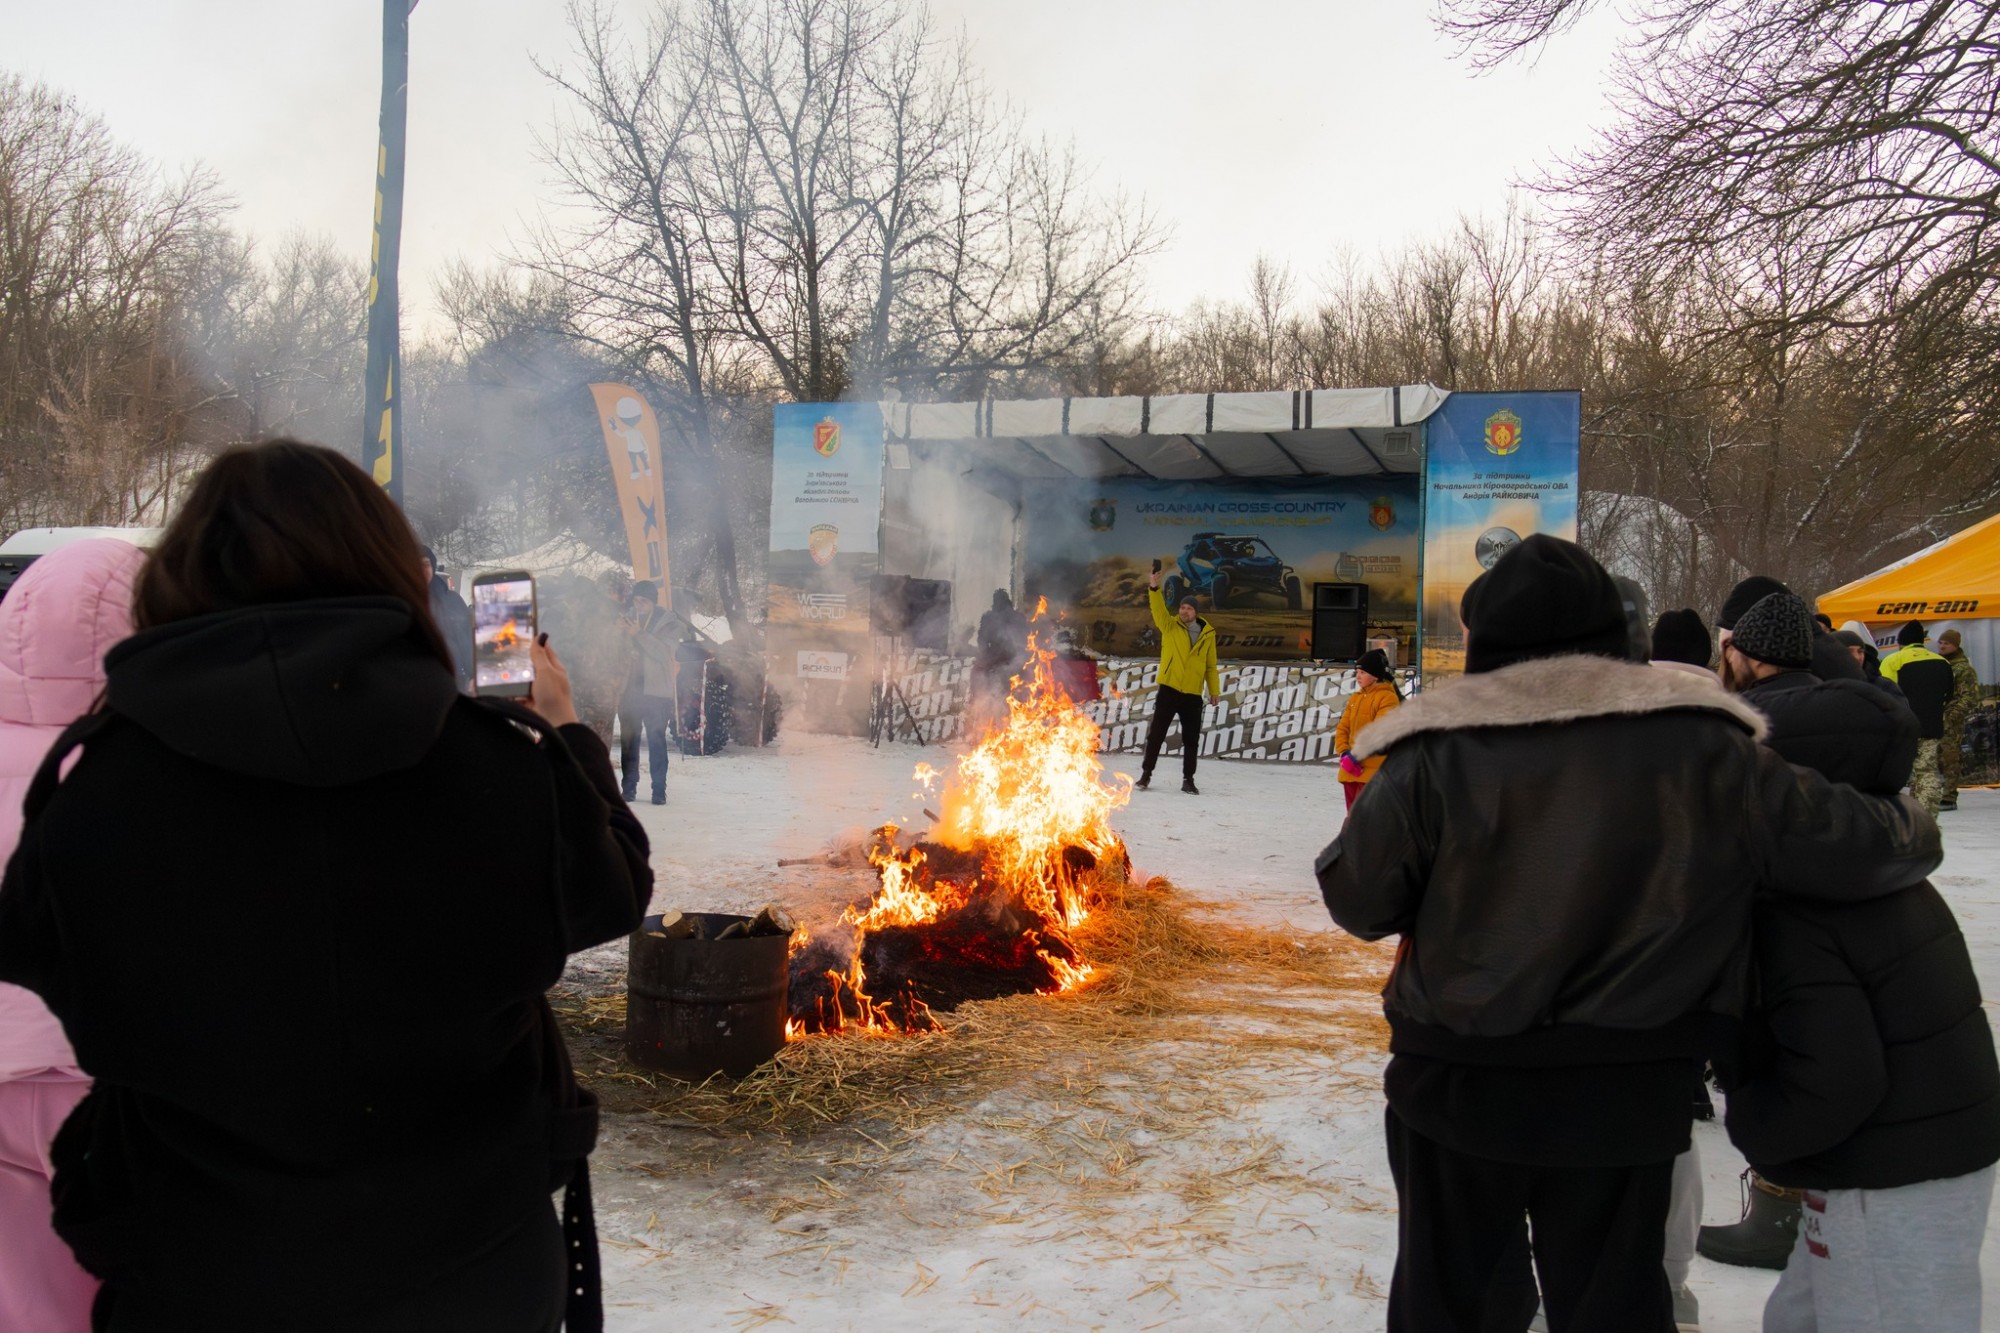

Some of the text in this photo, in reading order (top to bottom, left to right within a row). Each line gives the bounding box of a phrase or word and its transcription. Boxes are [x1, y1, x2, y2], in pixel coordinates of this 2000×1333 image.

[1472, 472, 1531, 482] За підтримки
[1483, 482, 1551, 492] Кіровоградської
[1462, 491, 1540, 501] Андрія РАЙКОВИЧА
[1136, 501, 1347, 514] UKRAINIAN CROSS-COUNTRY
[799, 605, 847, 619] WORLD
[1876, 600, 1979, 615] can-am
